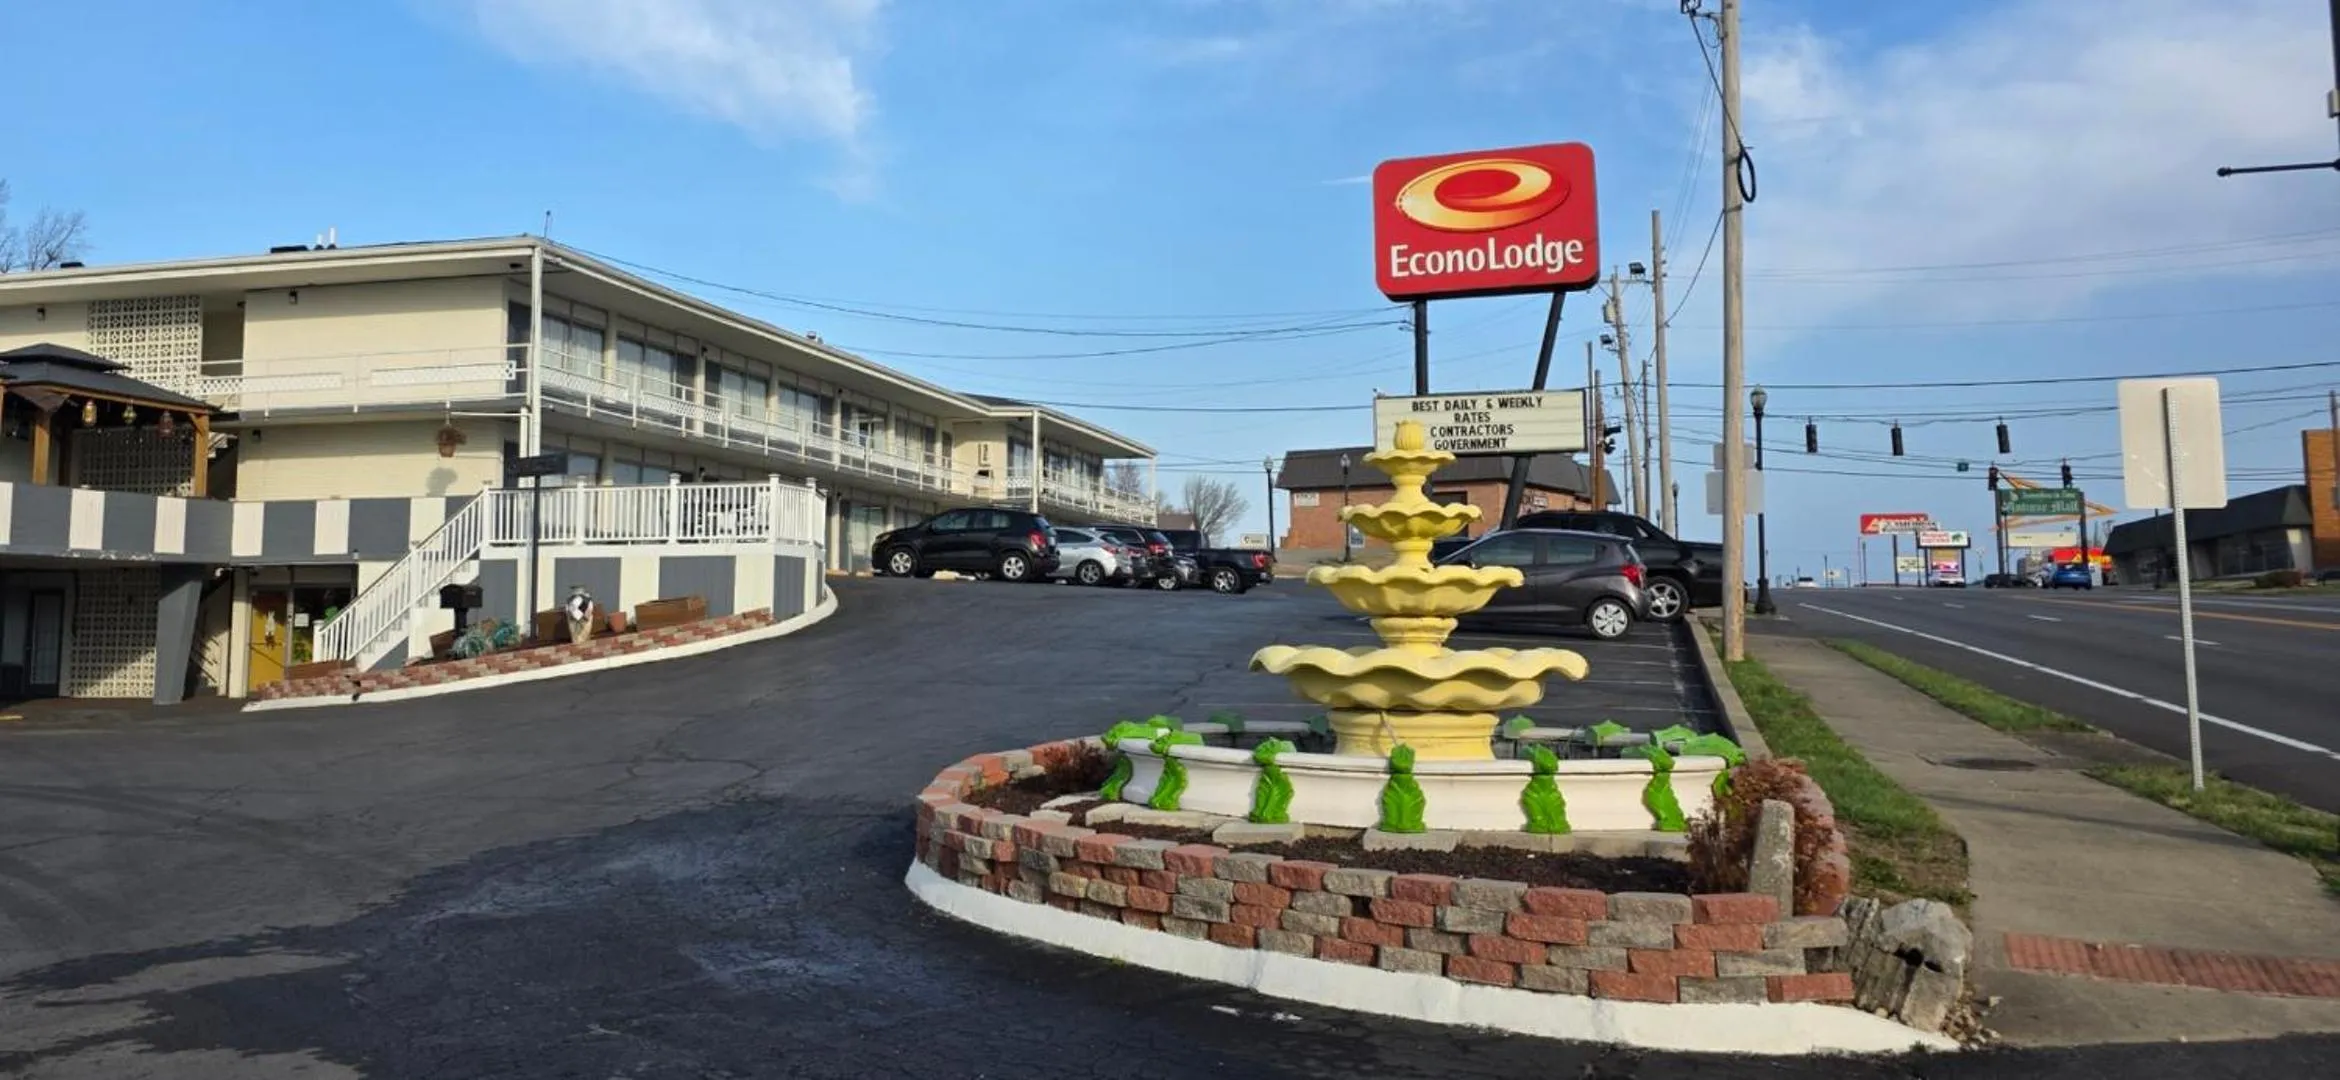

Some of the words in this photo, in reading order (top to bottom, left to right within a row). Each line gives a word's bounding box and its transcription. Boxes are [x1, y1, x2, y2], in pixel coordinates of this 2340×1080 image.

[1390, 233, 1584, 278] EconoLodge
[1412, 400, 1439, 412] BEST
[1444, 398, 1478, 411] DAILY
[1498, 395, 1543, 409] WEEKLY
[1454, 411, 1491, 423] RATES
[1430, 424, 1514, 437] CONTRACTORS
[1434, 437, 1508, 450] GOVERNMENT
